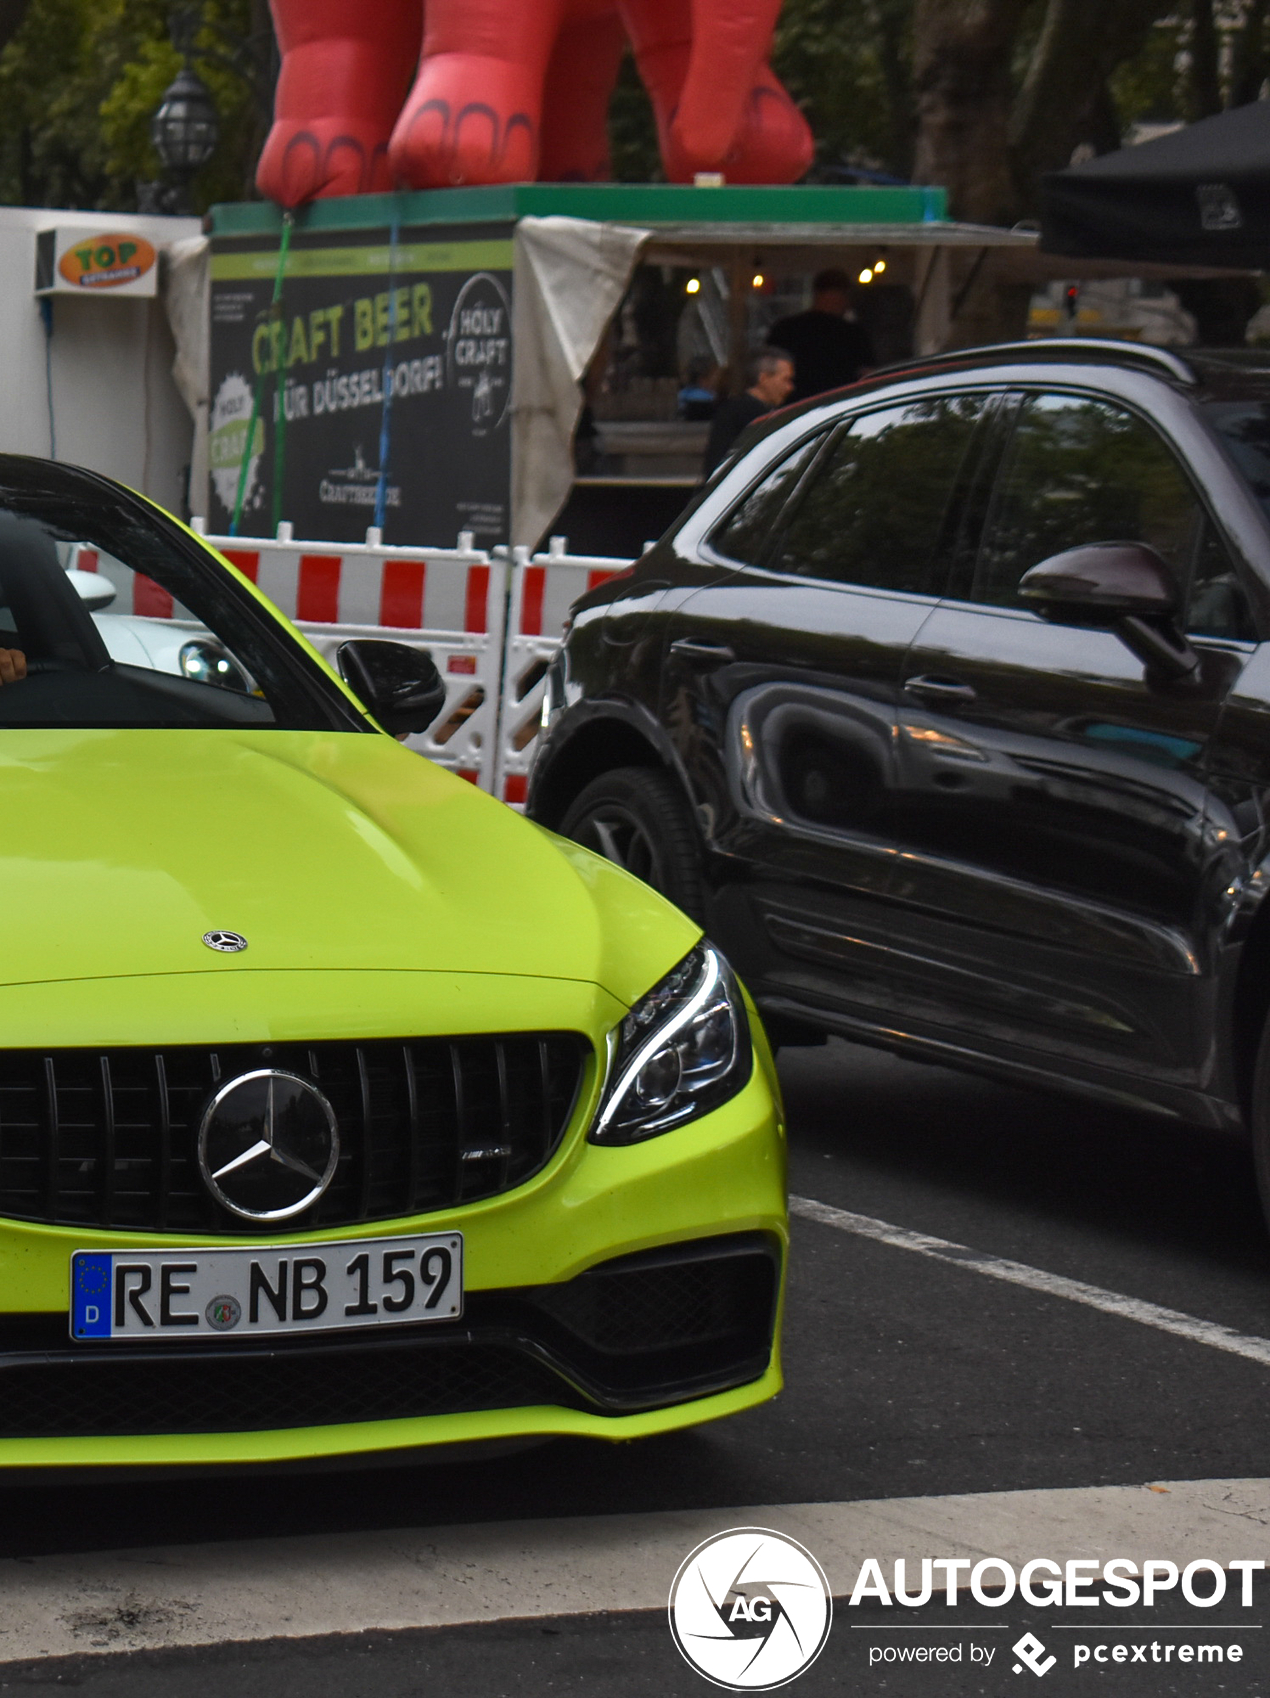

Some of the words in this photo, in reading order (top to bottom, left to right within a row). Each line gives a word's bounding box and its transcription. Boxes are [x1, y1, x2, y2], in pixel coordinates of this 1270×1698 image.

[75, 241, 137, 271] TOP
[251, 304, 345, 376] CRAFT
[353, 282, 434, 353] BEER
[459, 309, 502, 336] HOLY
[454, 339, 508, 367] CRAFT
[114, 1263, 200, 1328] RE
[249, 1257, 329, 1324] NB
[344, 1246, 453, 1318] 159
[85, 1306, 99, 1323] D
